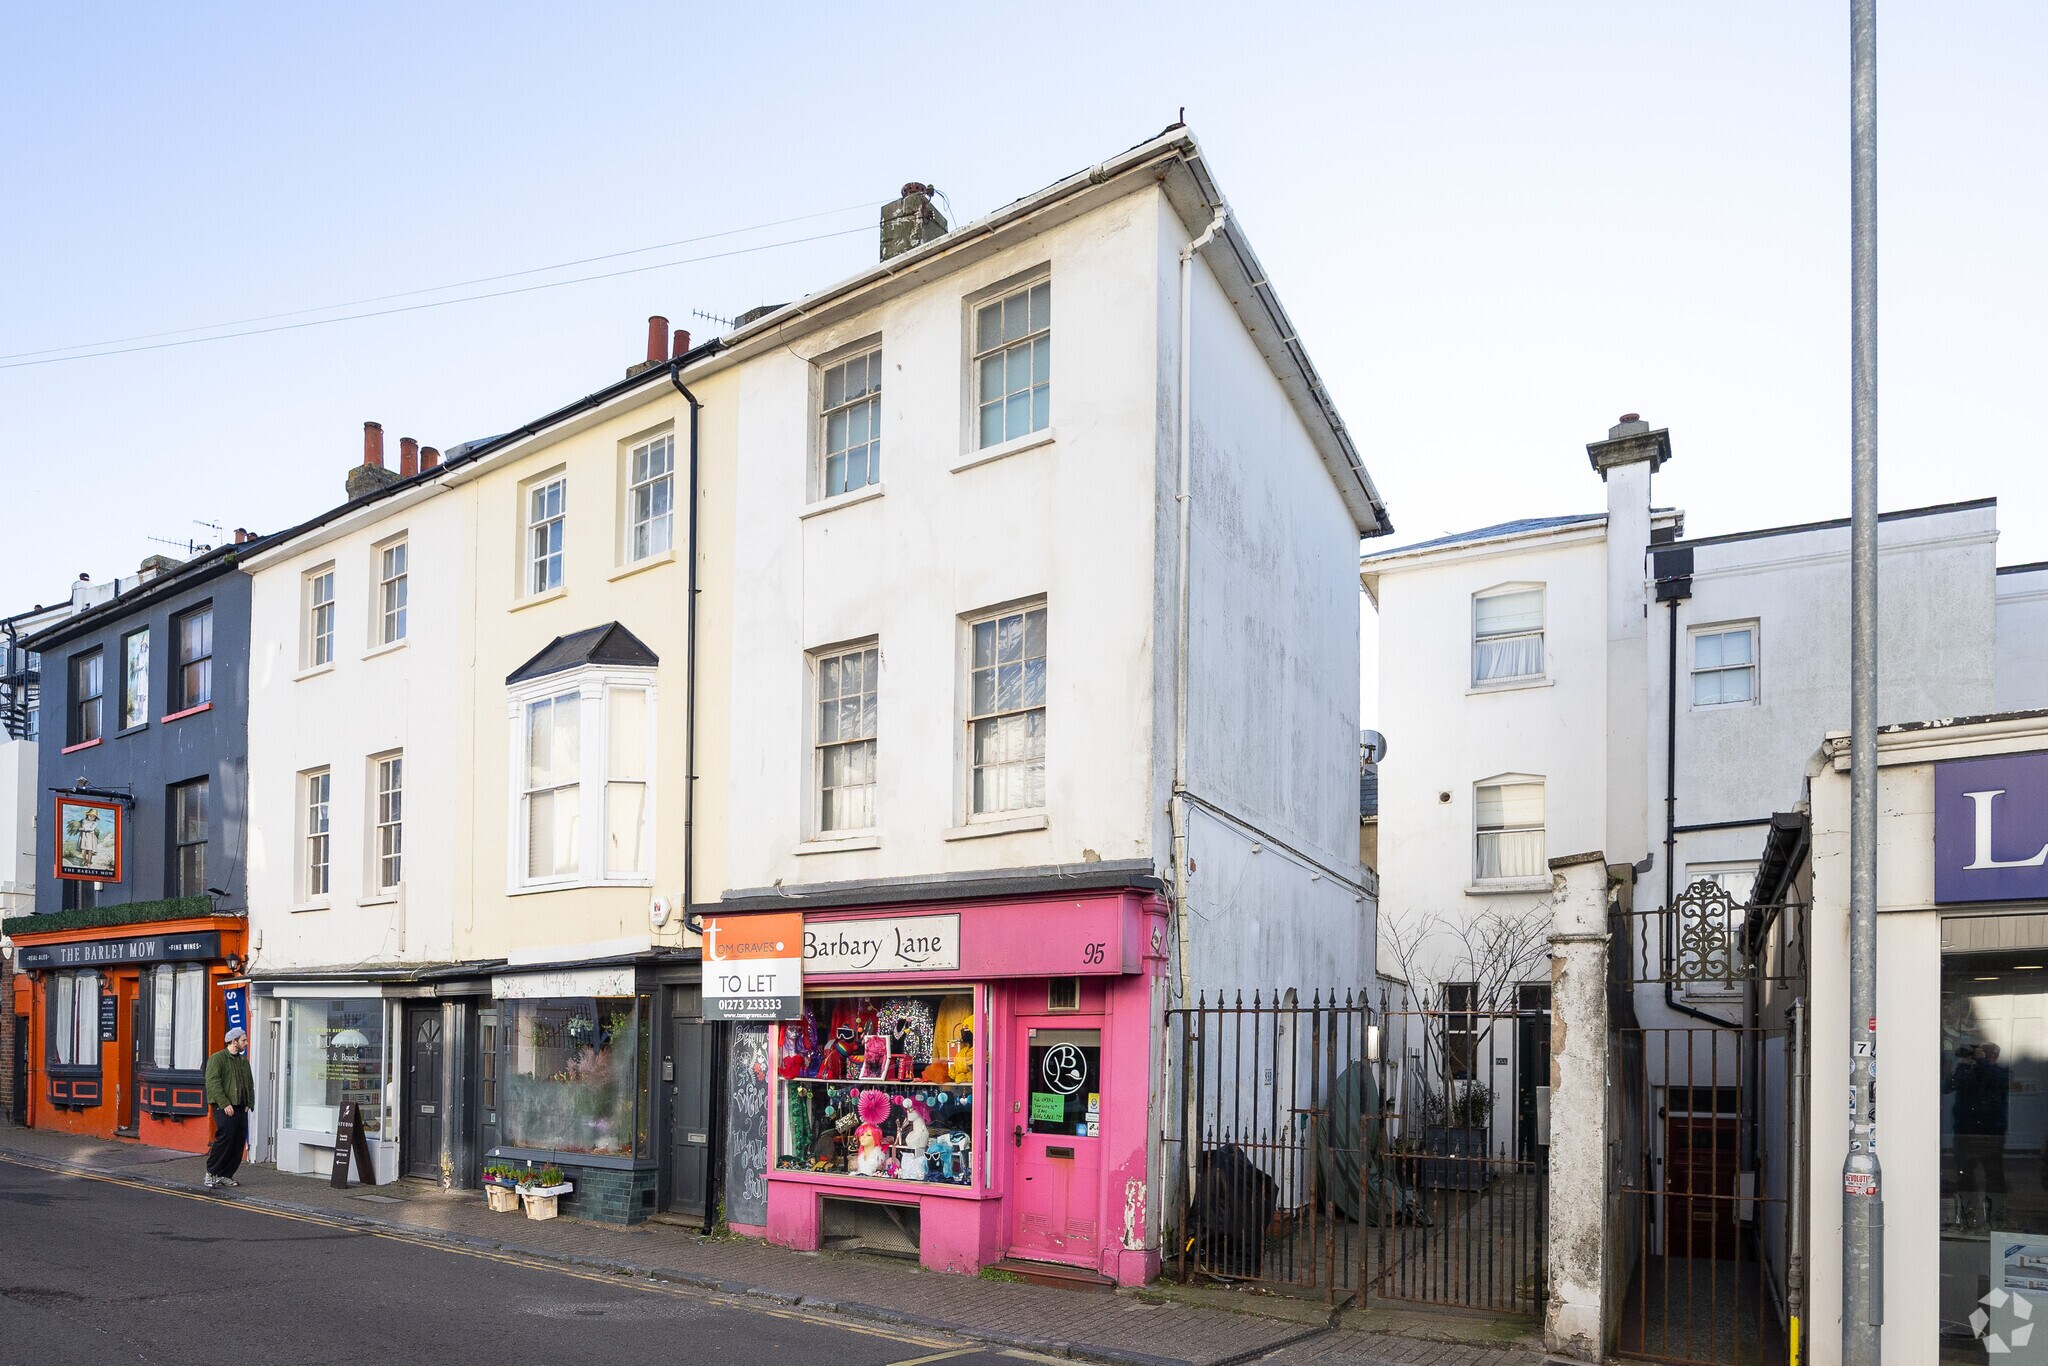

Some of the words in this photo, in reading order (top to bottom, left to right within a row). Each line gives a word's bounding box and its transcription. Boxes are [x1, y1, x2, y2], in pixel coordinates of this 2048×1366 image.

[1962, 789, 2048, 870] L
[61, 948, 80, 962] THE
[84, 944, 124, 961] BARLEY
[129, 941, 156, 958] MOW
[183, 942, 199, 950] WINES
[736, 941, 775, 953] GRAVES
[803, 931, 883, 968] Barbary
[895, 927, 942, 963] Lane
[1083, 942, 1106, 965] 95
[718, 975, 742, 993] TO
[747, 974, 777, 993] LET
[718, 999, 744, 1011] 01273
[746, 998, 782, 1011] 233333
[723, 1011, 777, 1019] www.tomgraves.co.uk
[1857, 1043, 1867, 1054] 7
